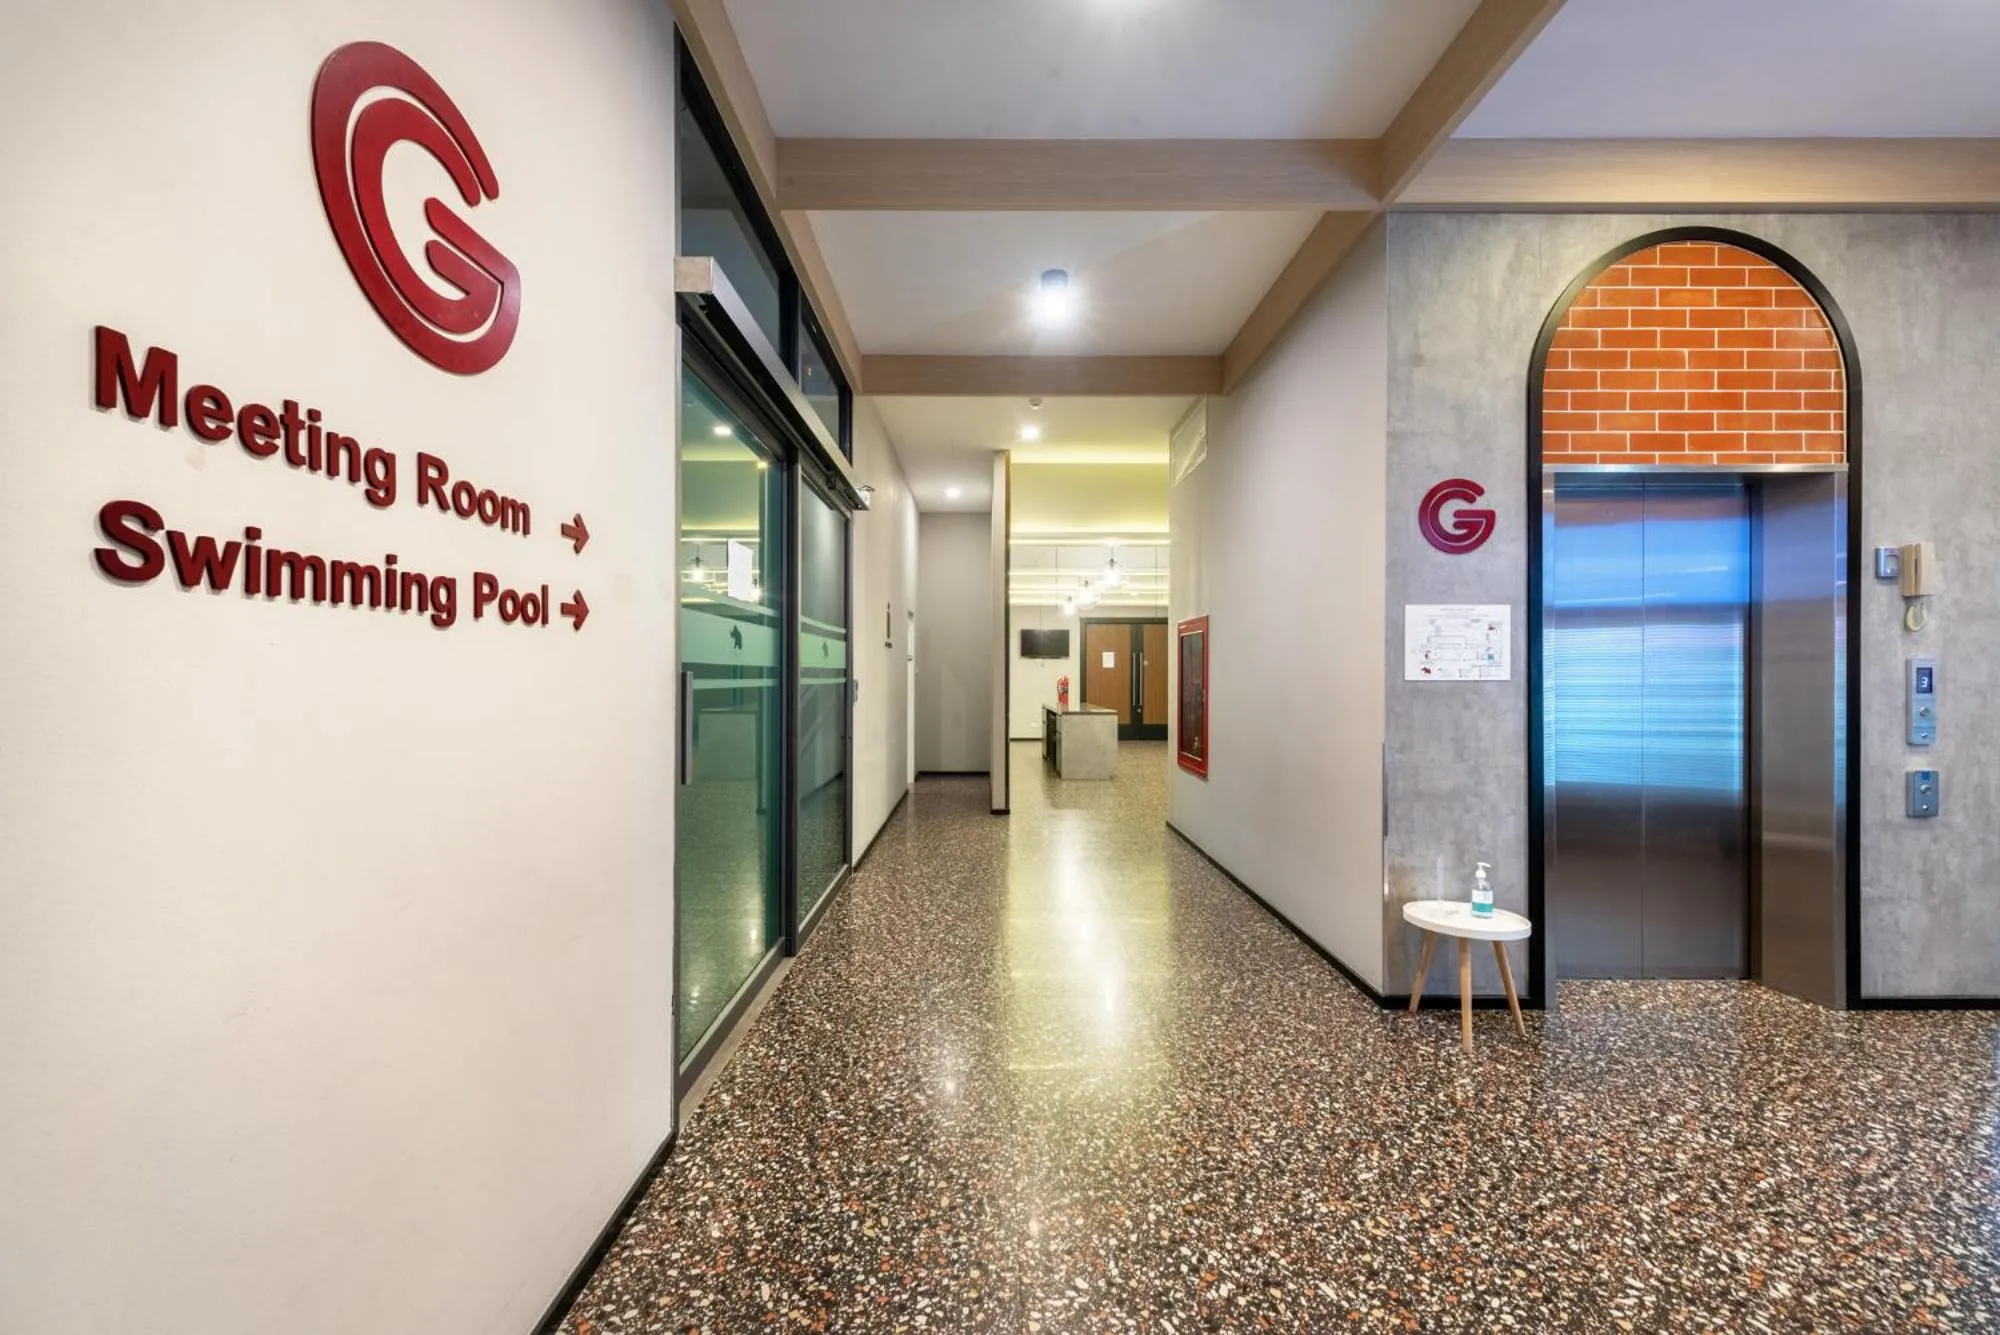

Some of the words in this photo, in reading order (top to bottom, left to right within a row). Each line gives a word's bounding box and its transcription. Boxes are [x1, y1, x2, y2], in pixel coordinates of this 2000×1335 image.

[311, 41, 520, 376] G
[95, 325, 396, 508] Meeting
[417, 452, 531, 535] Room
[94, 500, 457, 628] Swimming
[473, 572, 549, 626] Pool
[1418, 478, 1497, 555] G
